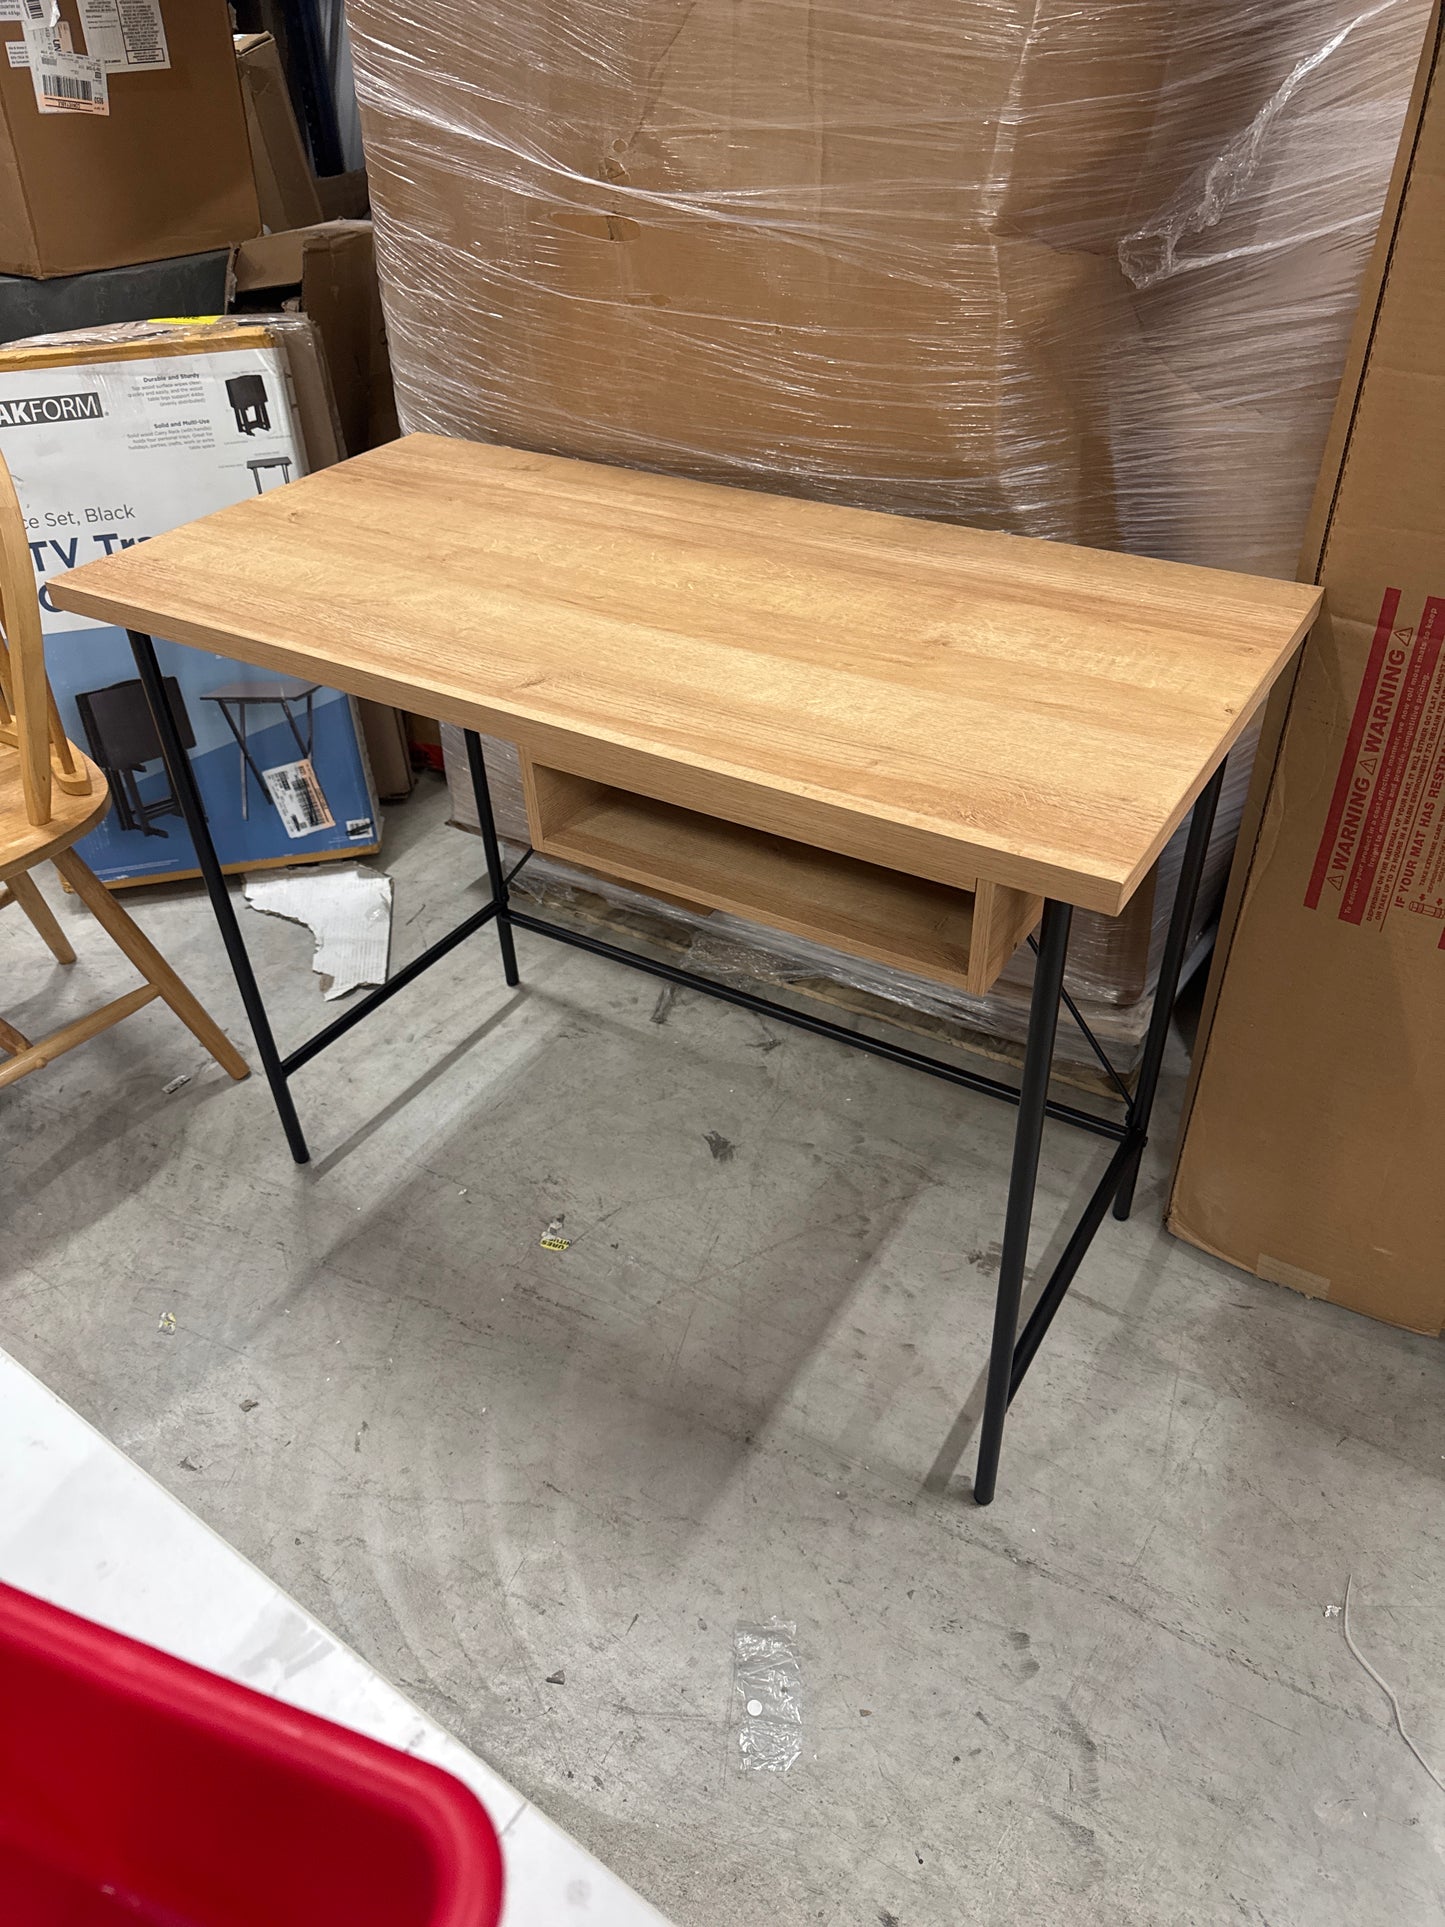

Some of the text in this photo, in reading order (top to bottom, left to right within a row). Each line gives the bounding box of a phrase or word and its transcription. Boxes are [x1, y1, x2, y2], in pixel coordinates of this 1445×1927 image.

[45, 511, 81, 532] Set,
[85, 504, 136, 523] Black
[29, 537, 78, 572] TV
[1427, 695, 1438, 713] FLAT
[1437, 700, 1445, 713] ITS
[1367, 825, 1374, 833] in
[1372, 801, 1382, 818] cost
[1378, 767, 1391, 800] effective
[1397, 720, 1405, 733] we
[1401, 702, 1409, 719] now
[1405, 686, 1414, 701] roll
[1410, 664, 1421, 686] most
[1416, 642, 1427, 663] mats
[1426, 606, 1437, 629] keep
[1423, 714, 1432, 725] GO
[1430, 713, 1441, 741] REGAIN
[1388, 783, 1397, 798] and
[1402, 704, 1420, 752] competitive
[1415, 671, 1430, 704] pricing.
[1424, 742, 1433, 753] TO
[1332, 649, 1405, 870] WARNING WARNING
[1397, 797, 1408, 817] YOUR
[1404, 803, 1414, 825] WARM
[1420, 800, 1434, 827] HAS
[1393, 817, 1401, 827] OF
[1385, 828, 1397, 860] MATERIAL
[1398, 831, 1406, 839] IN
[1411, 829, 1425, 857] MAT
[1393, 840, 1403, 863] HOURS
[1381, 860, 1389, 874] THE
[1389, 863, 1396, 872] 72
[1400, 858, 1417, 894] YOUR
[1376, 874, 1384, 884] ON
[1383, 883, 1391, 893] UP
[1386, 873, 1393, 883] TO
[1367, 885, 1380, 921] DEPENDING
[1378, 893, 1388, 910] TAKE
[1395, 895, 1406, 908] IF
